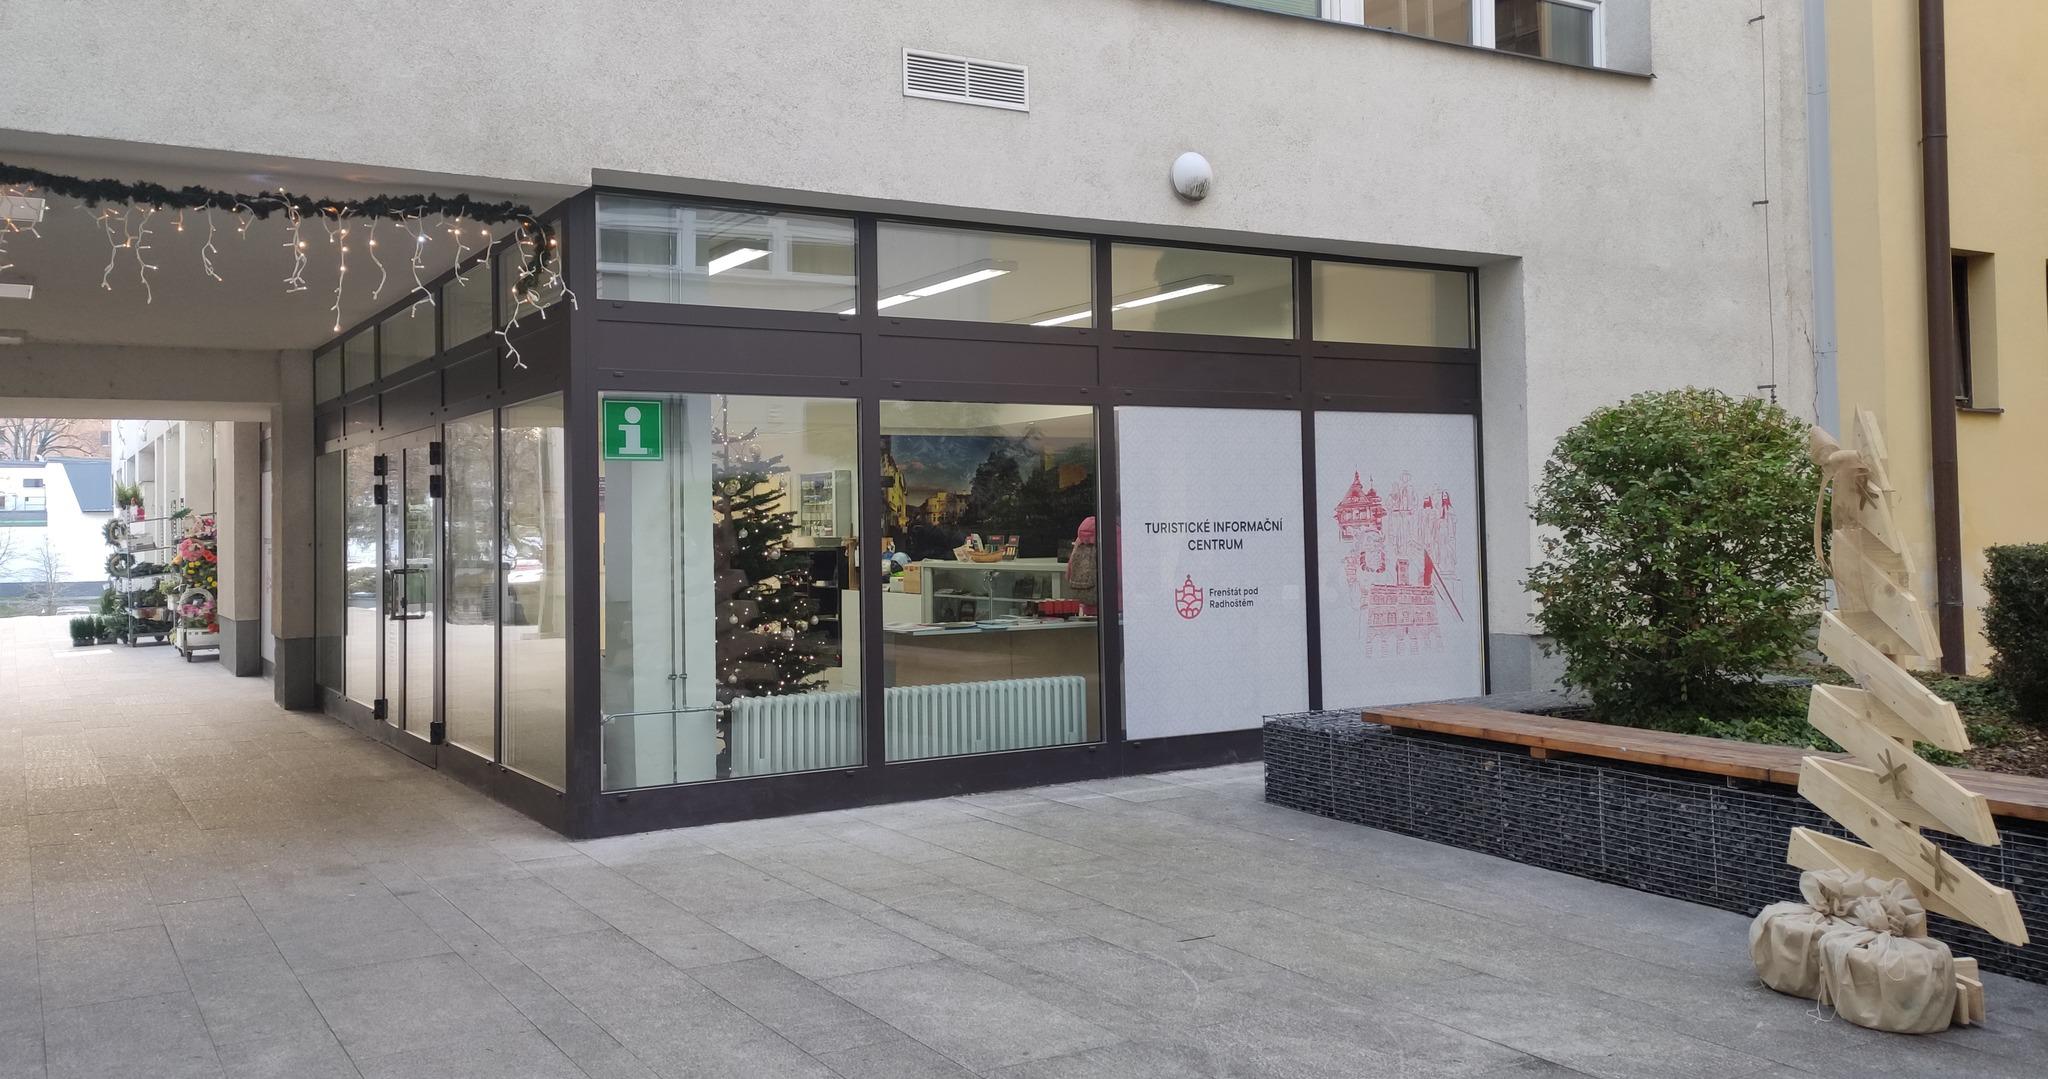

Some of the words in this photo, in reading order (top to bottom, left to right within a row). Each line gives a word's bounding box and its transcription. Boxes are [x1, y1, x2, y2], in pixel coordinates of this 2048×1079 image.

[1145, 519, 1210, 534] TURISTICKÉ
[1213, 517, 1283, 533] INFORMAČNÍ
[1188, 538, 1243, 551] CENTRUM
[1209, 587, 1242, 597] Frenštát
[1243, 587, 1259, 597] pod
